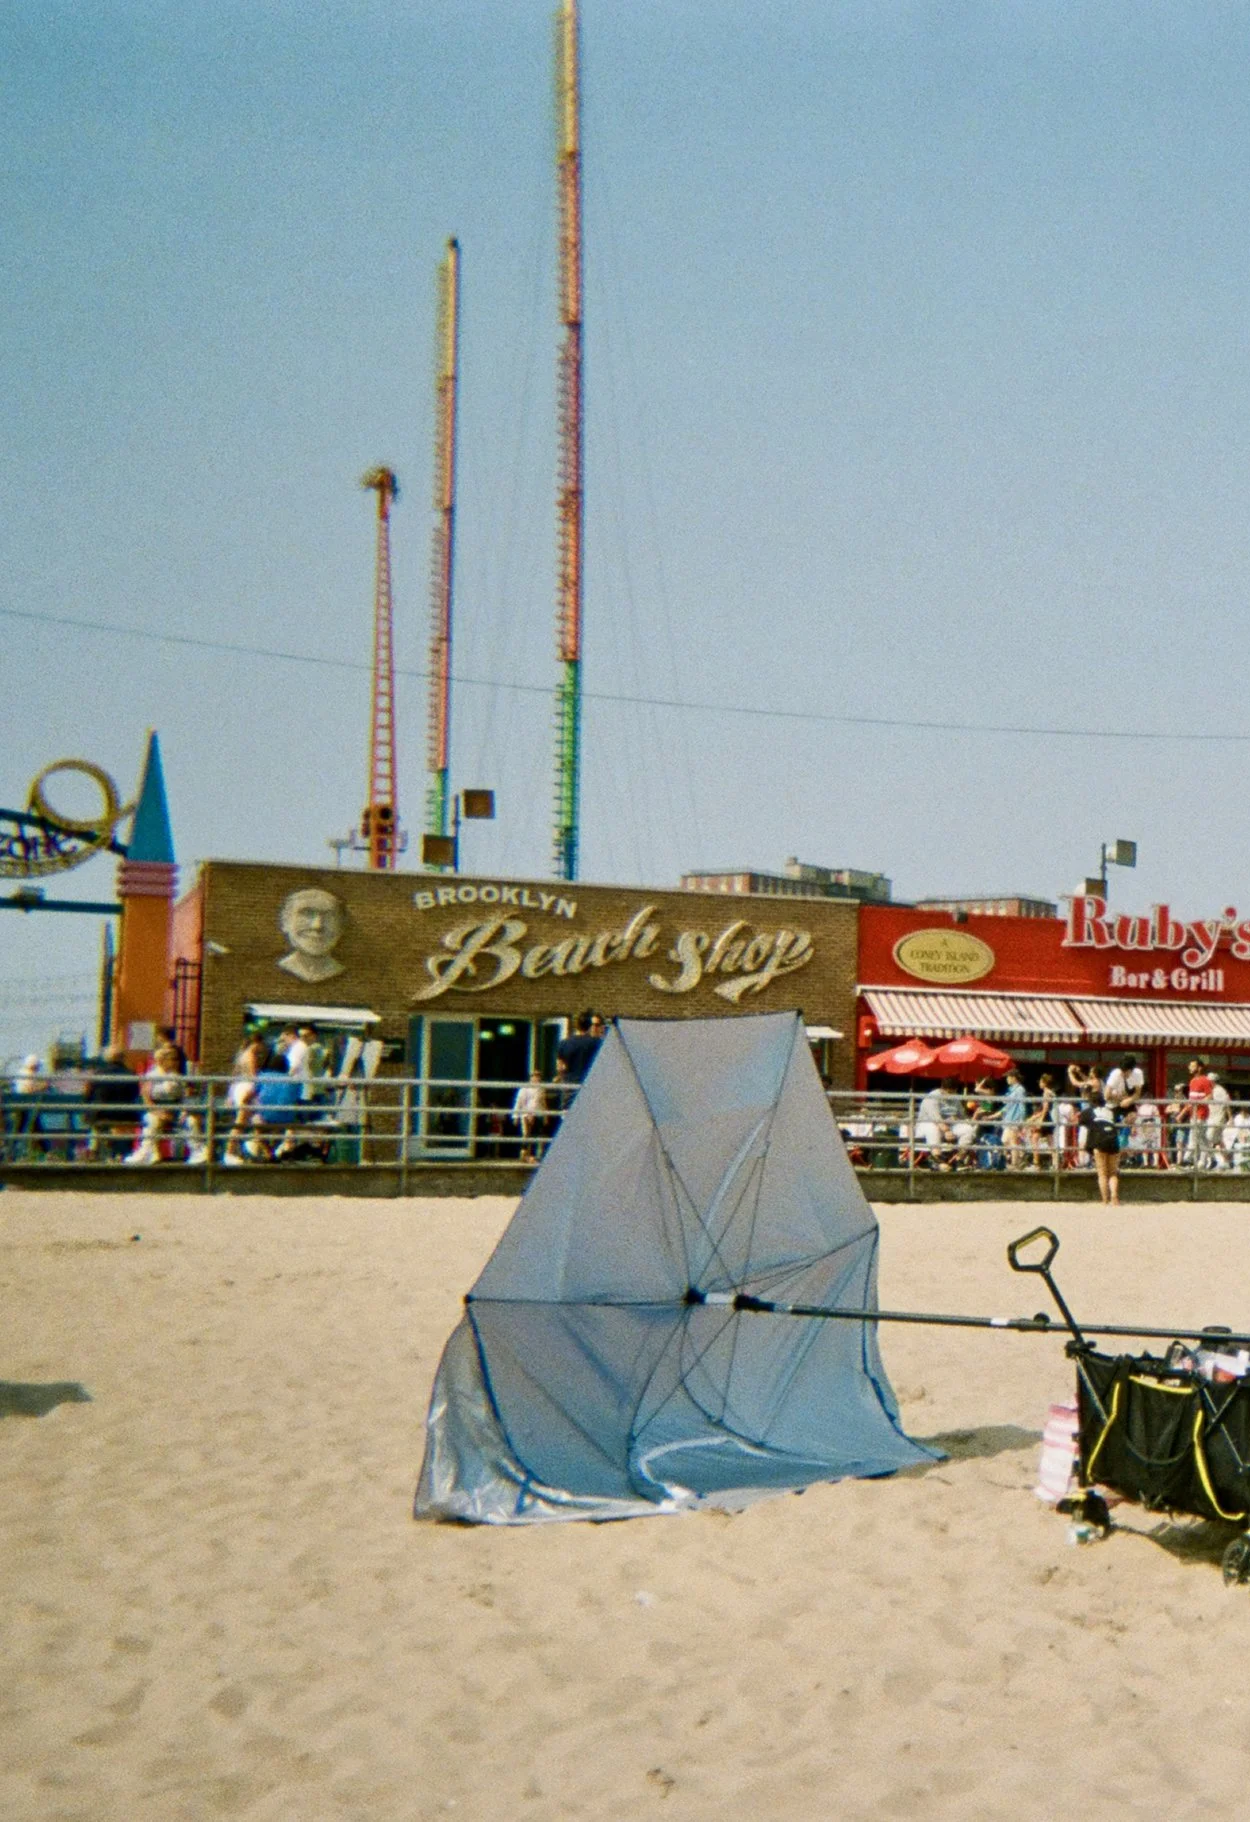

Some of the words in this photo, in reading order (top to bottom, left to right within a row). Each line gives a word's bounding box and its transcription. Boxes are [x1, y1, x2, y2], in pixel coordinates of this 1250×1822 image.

[414, 885, 577, 919] BROOKLYN
[411, 906, 660, 1001] Beach
[650, 920, 815, 1003] Shop
[1109, 964, 1149, 989] Bar
[1151, 968, 1168, 990] &
[1170, 968, 1225, 992] Grill
